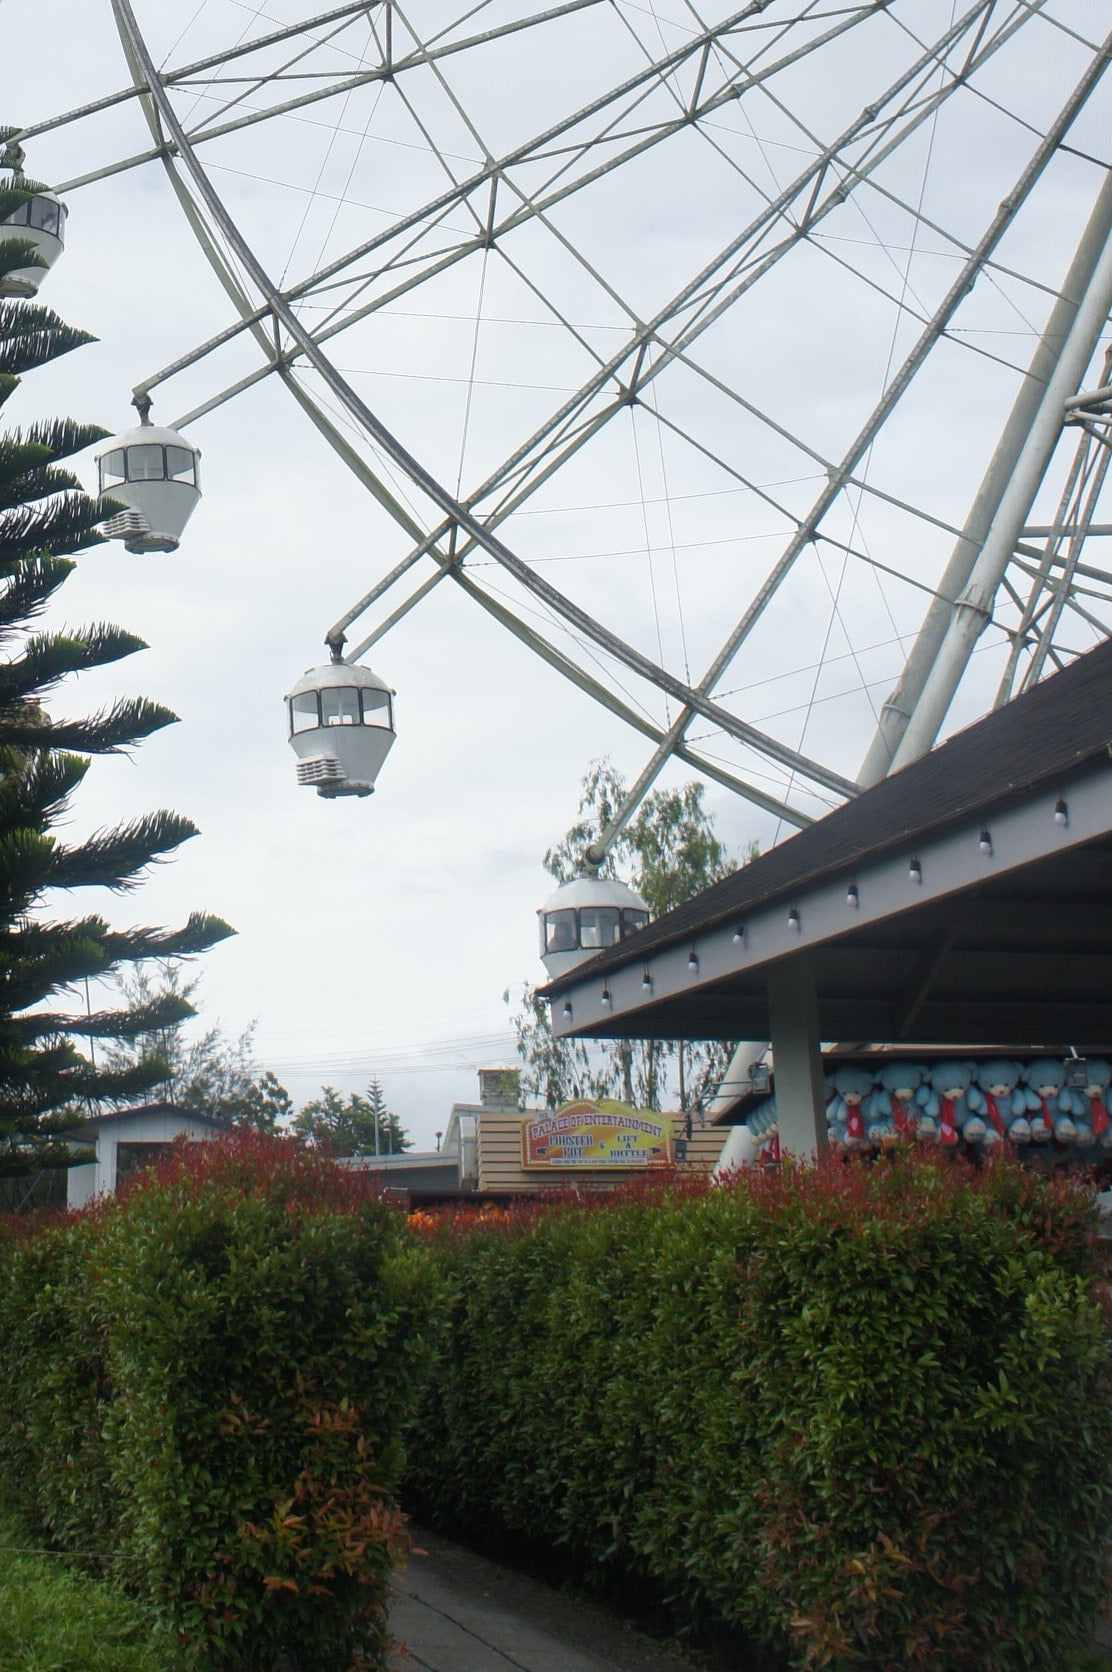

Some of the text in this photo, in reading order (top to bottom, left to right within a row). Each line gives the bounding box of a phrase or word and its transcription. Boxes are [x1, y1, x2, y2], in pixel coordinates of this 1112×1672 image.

[532, 1114, 662, 1139] PALACE OF ENTERTAINMENT
[549, 1135, 593, 1146] LOBSTER
[617, 1135, 638, 1143] LIFT
[563, 1147, 583, 1157] POT
